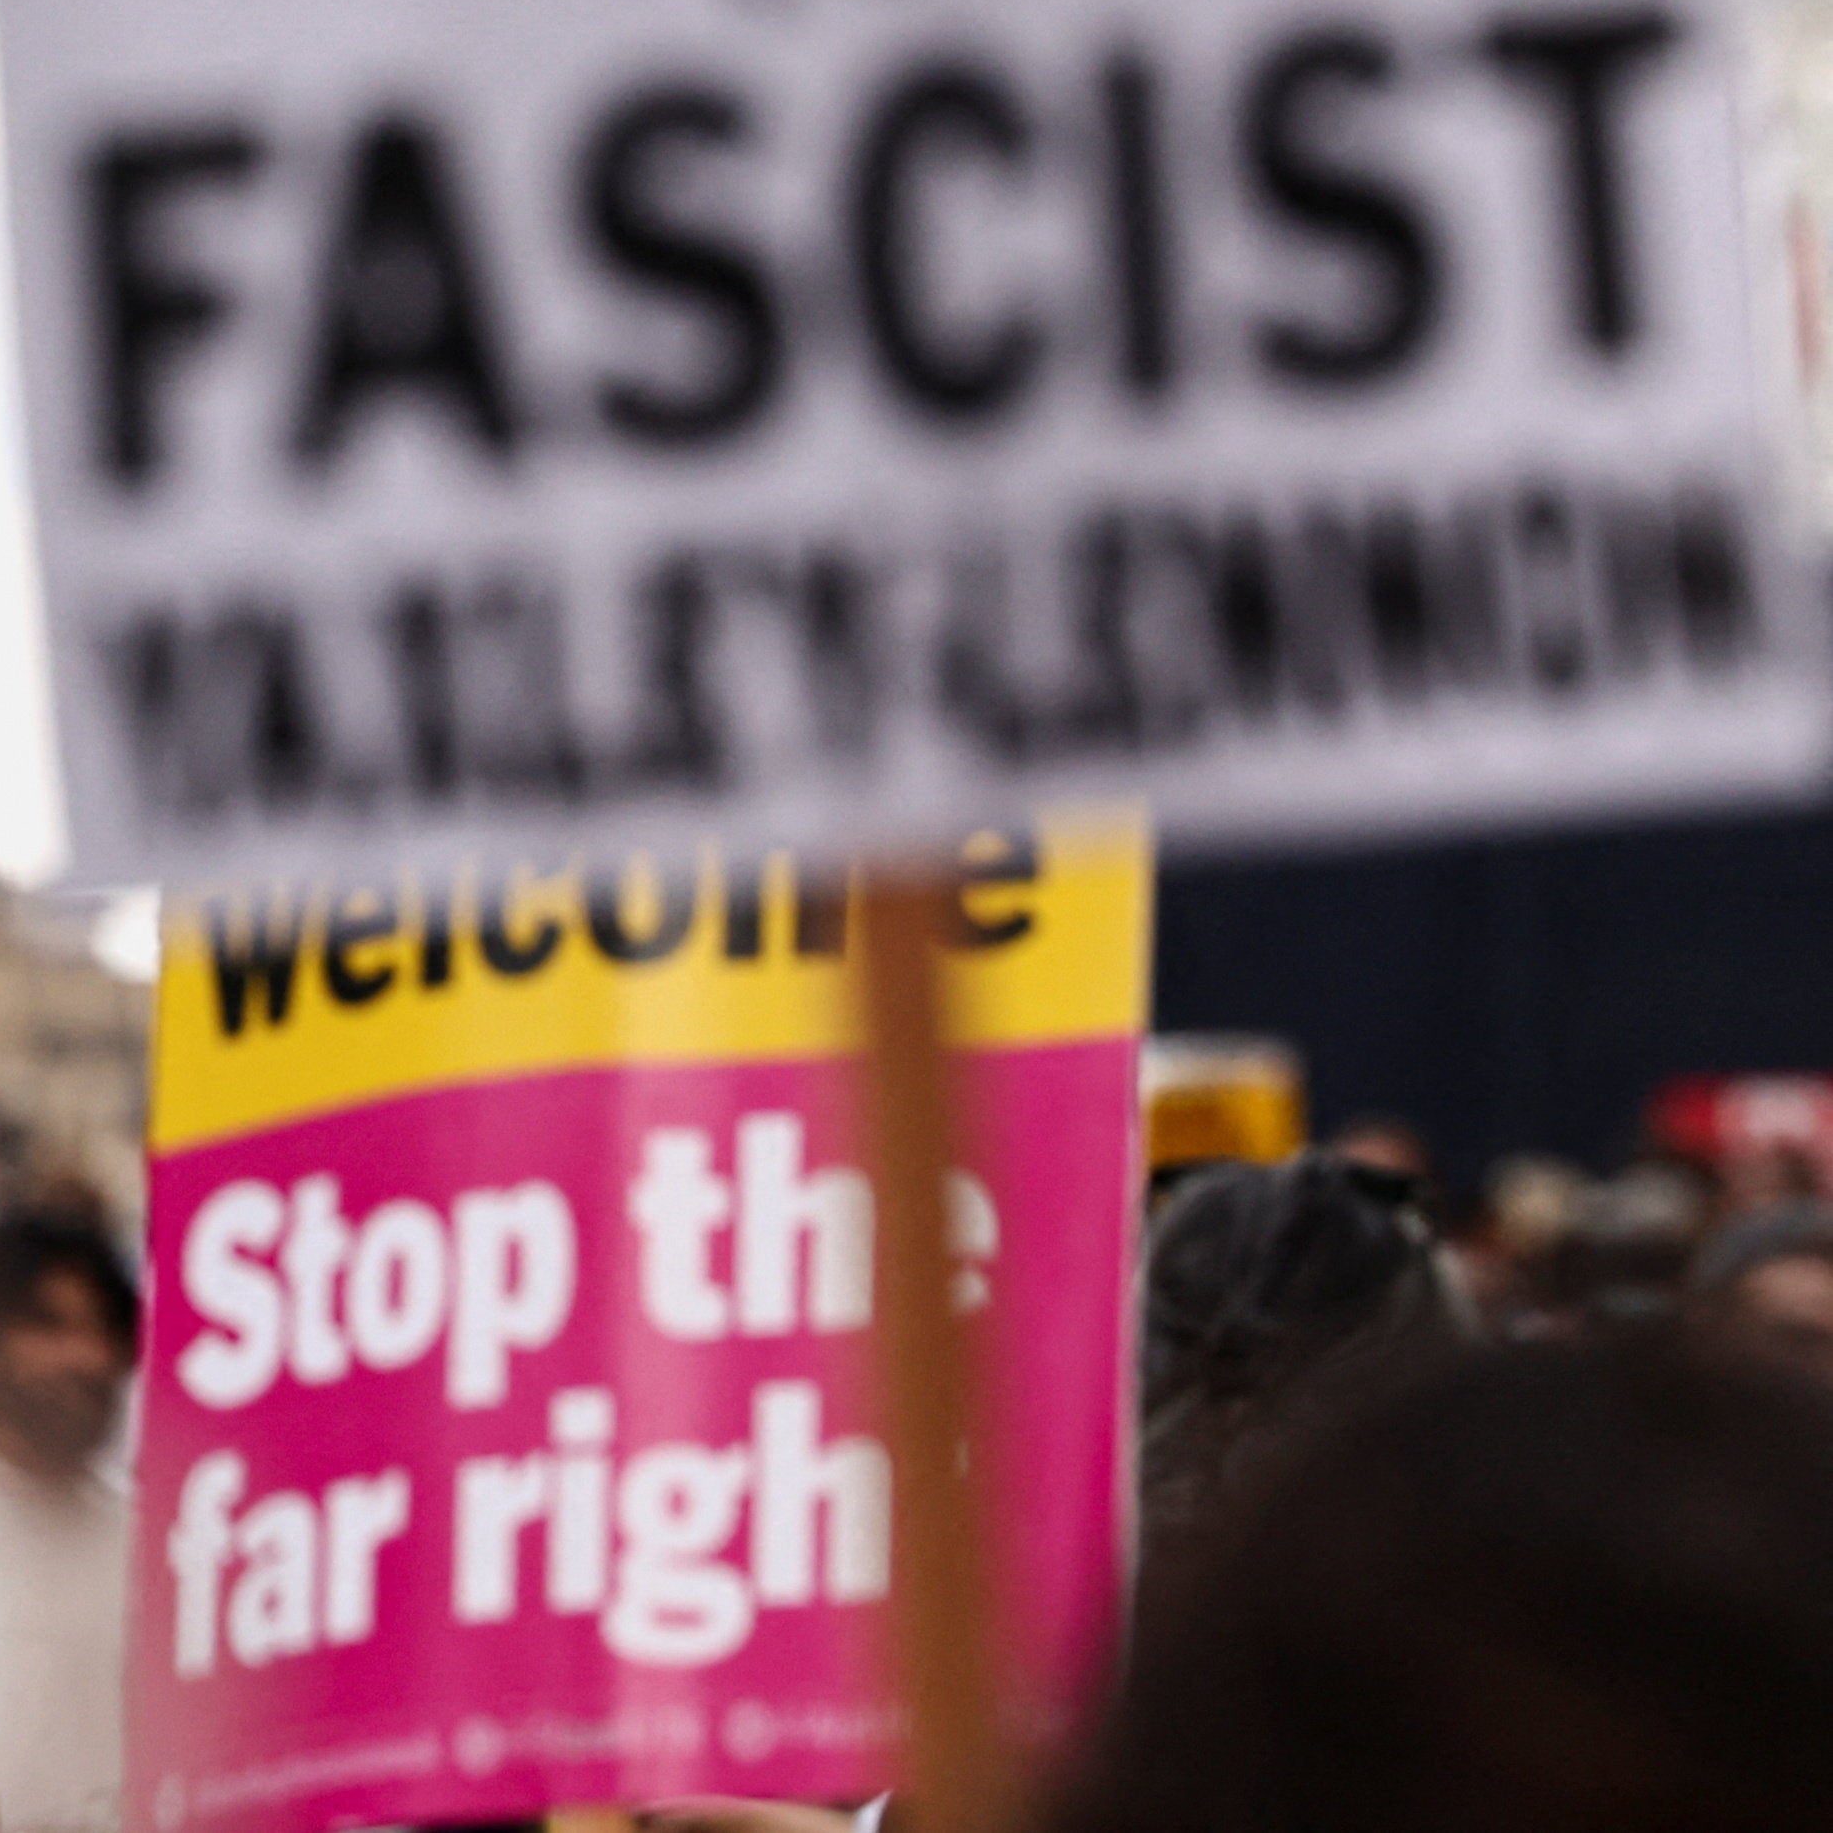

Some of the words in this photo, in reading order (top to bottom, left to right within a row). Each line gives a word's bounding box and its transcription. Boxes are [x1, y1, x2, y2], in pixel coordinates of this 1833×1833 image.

[178, 1171, 577, 1411] Stop
[169, 1451, 410, 1680] far
[447, 1378, 893, 1668] righ
